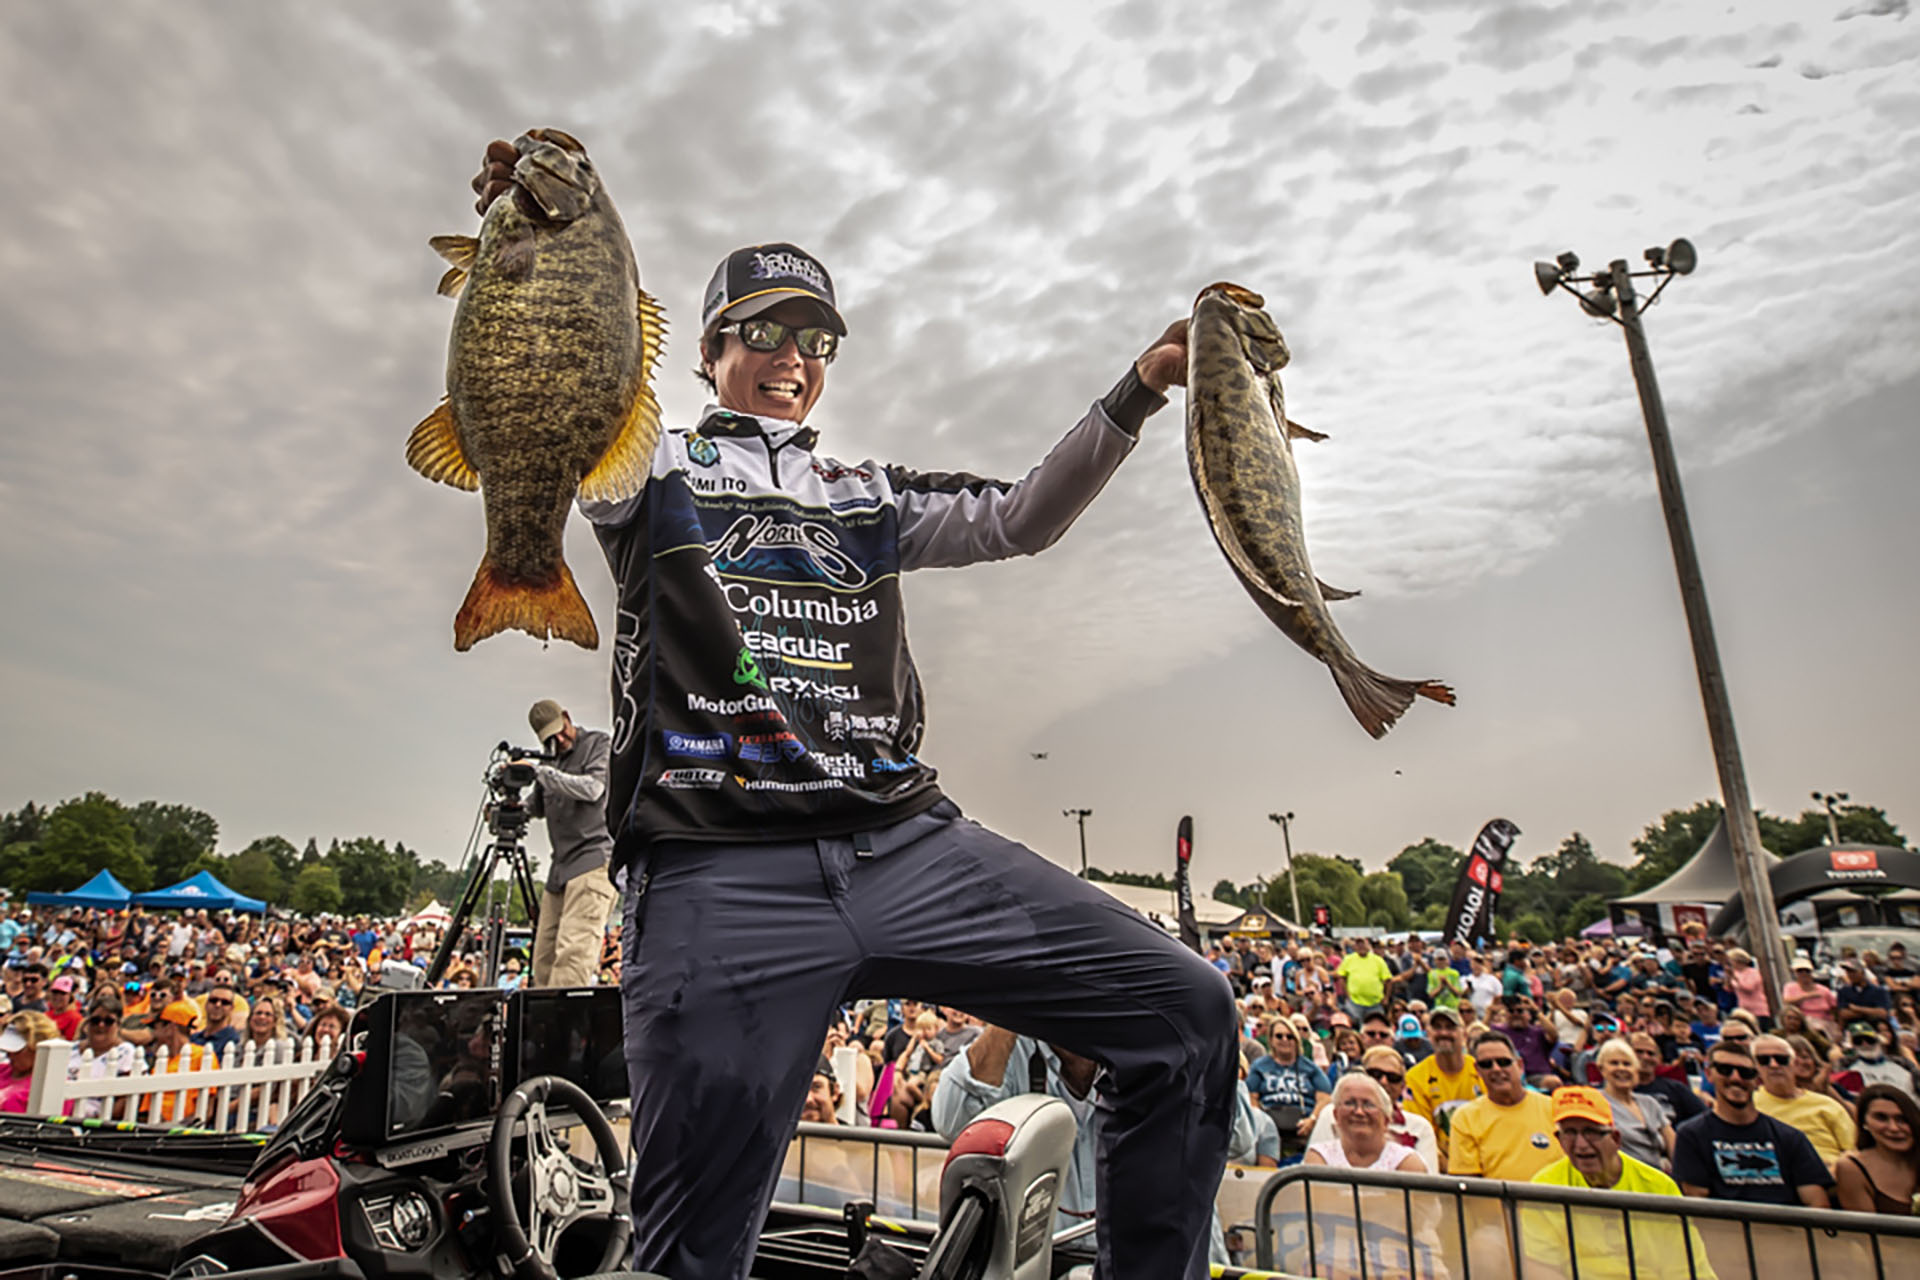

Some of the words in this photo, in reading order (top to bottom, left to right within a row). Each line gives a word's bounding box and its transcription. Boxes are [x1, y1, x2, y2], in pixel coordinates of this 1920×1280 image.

[722, 477, 747, 492] ITO
[722, 582, 879, 625] Columbia
[769, 677, 860, 700] RYUGI
[683, 738, 725, 750] YAMAHA
[814, 752, 857, 767] Tech
[745, 778, 844, 792] HUMMINBIRD
[1825, 869, 1887, 879] TOYOTA
[1453, 885, 1485, 951] TOYOTA
